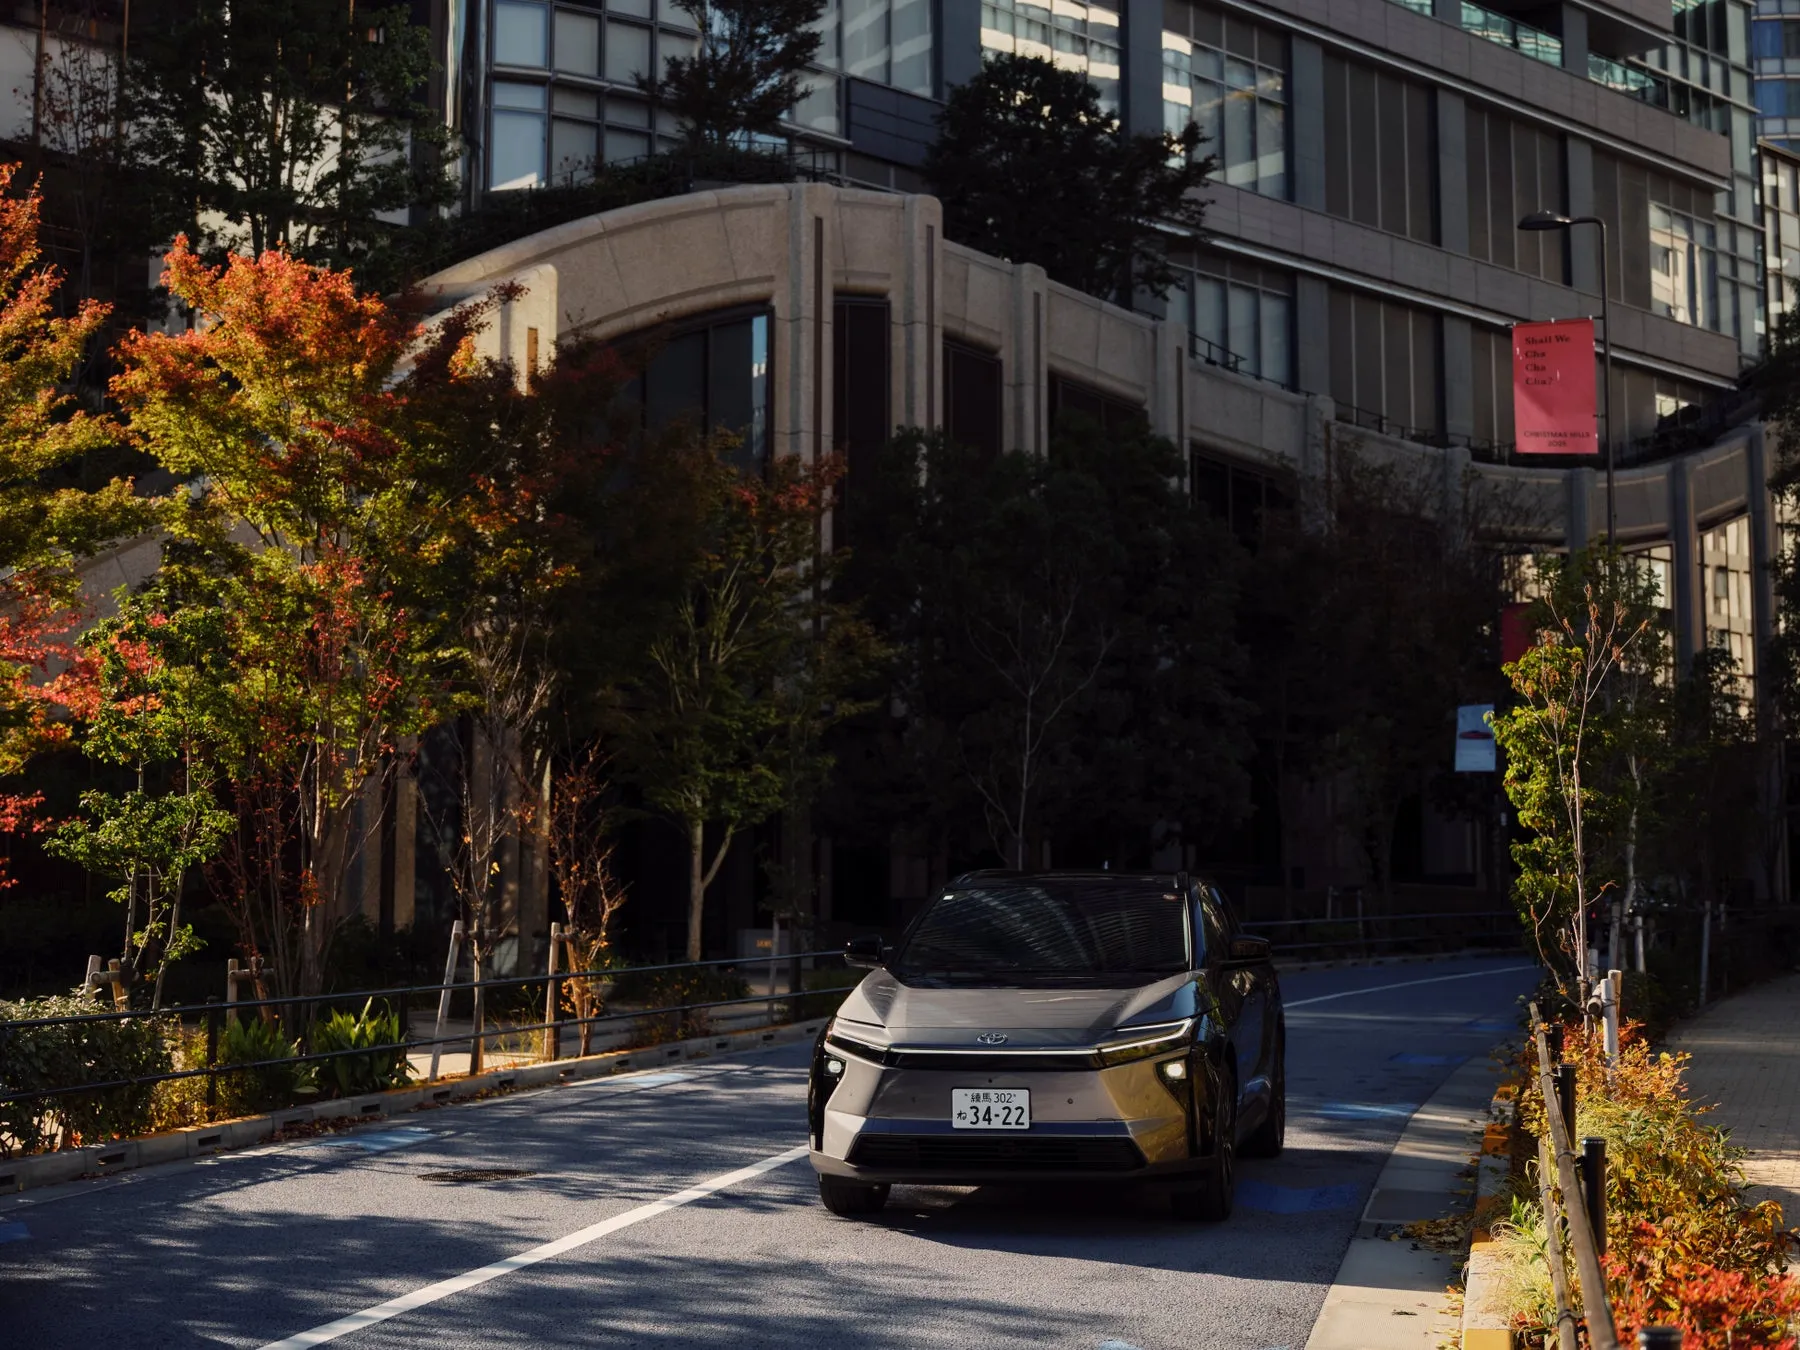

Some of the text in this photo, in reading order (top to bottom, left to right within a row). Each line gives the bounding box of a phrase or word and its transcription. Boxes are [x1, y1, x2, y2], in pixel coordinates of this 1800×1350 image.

[1525, 334, 1570, 345] Shall We
[1525, 350, 1546, 358] Cha
[1525, 363, 1546, 372] Cha
[1525, 376, 1553, 385] Cha?
[1523, 430, 1568, 438] CHRISTMAS
[971, 1092, 1012, 1103] 練馬 302
[957, 1106, 1024, 1125] ね 34-22
